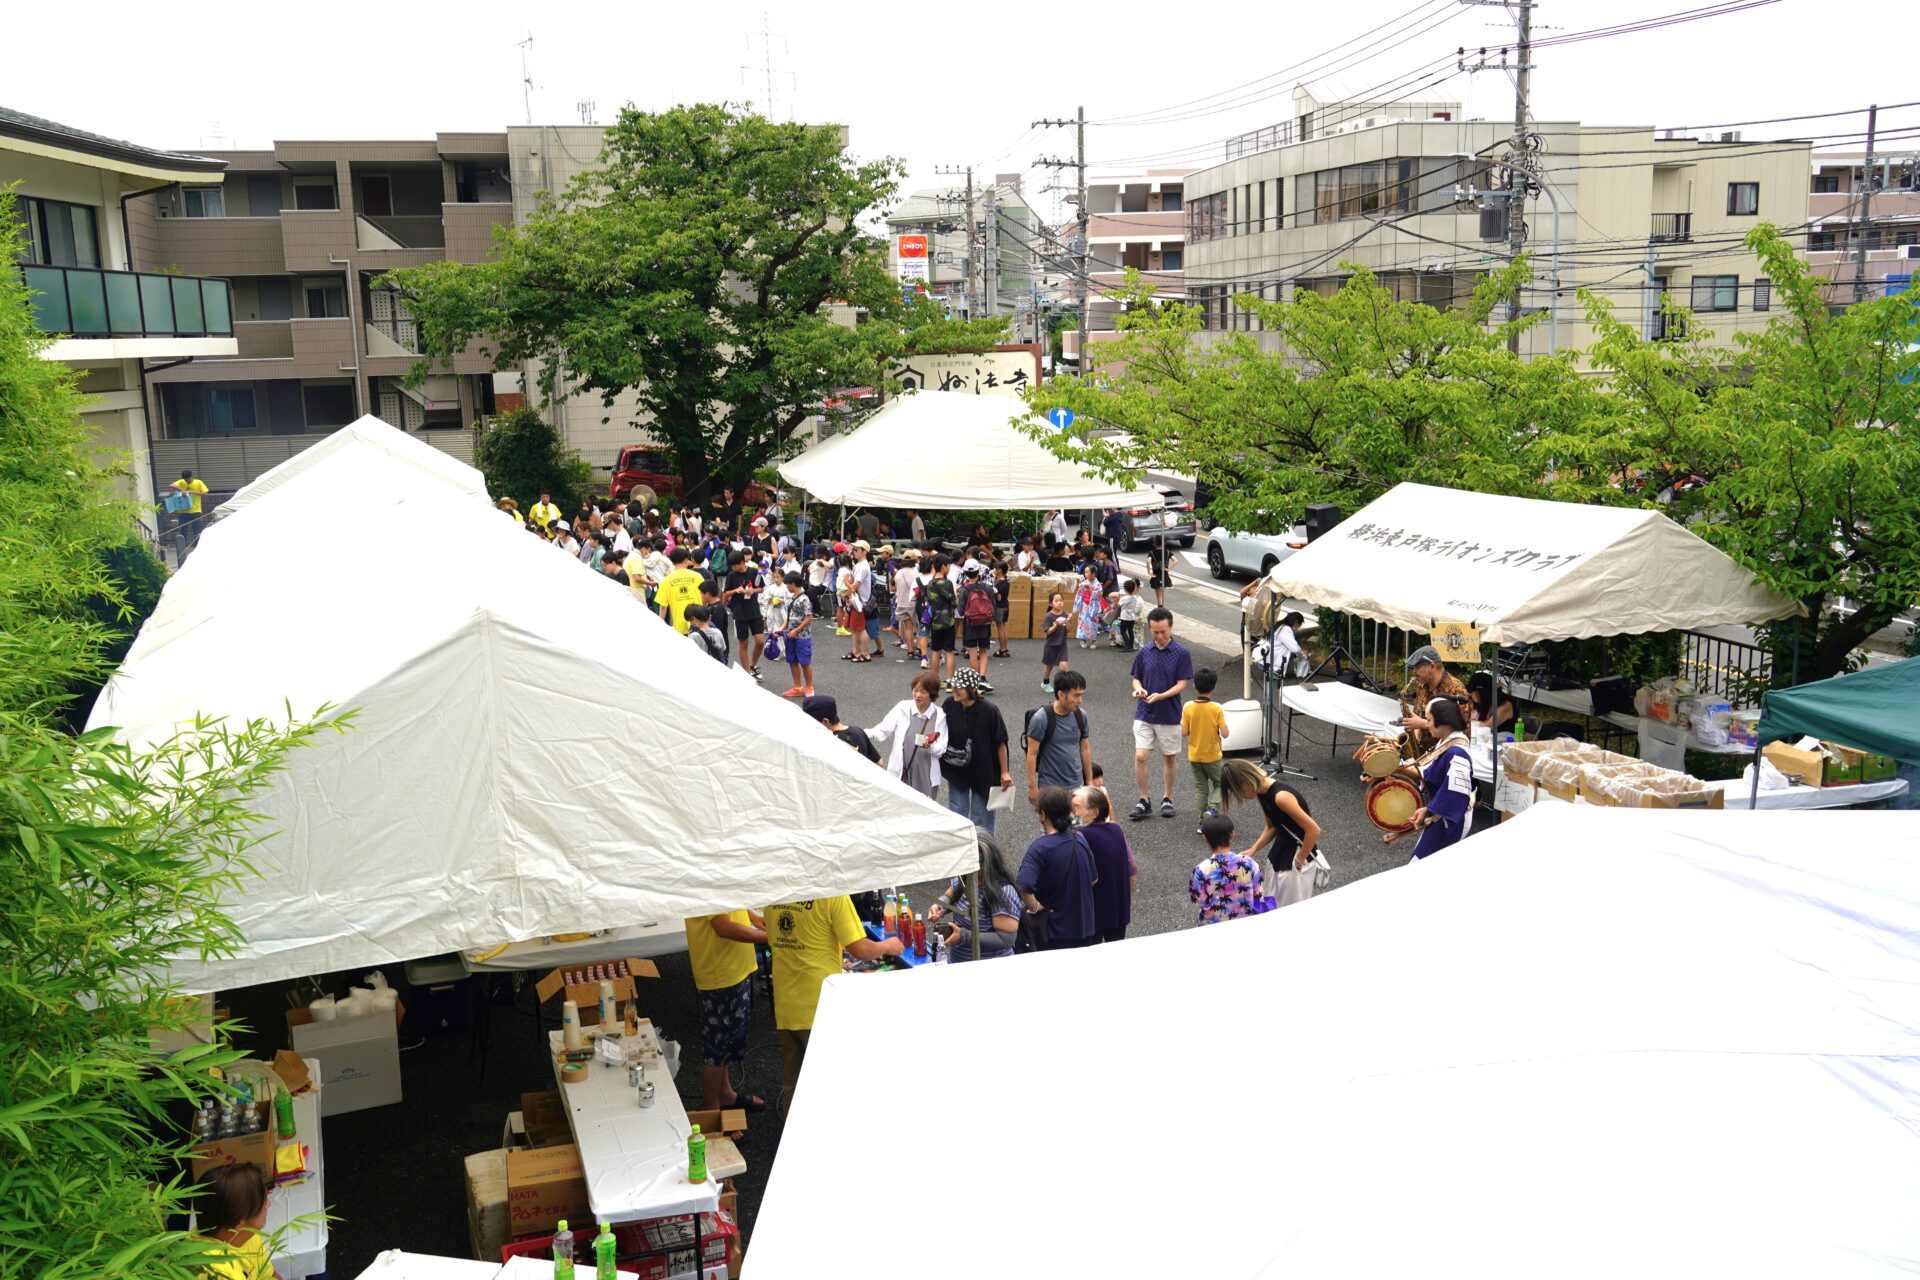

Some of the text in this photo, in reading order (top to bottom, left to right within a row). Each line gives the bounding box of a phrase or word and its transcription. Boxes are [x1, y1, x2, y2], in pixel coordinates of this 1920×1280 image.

[938, 367, 1029, 396] 妙法寺
[1347, 523, 1586, 572] 横浜東戸塚ライオンズクラブ
[511, 1189, 539, 1201] HATA
[670, 1253, 696, 1268] Asahi
